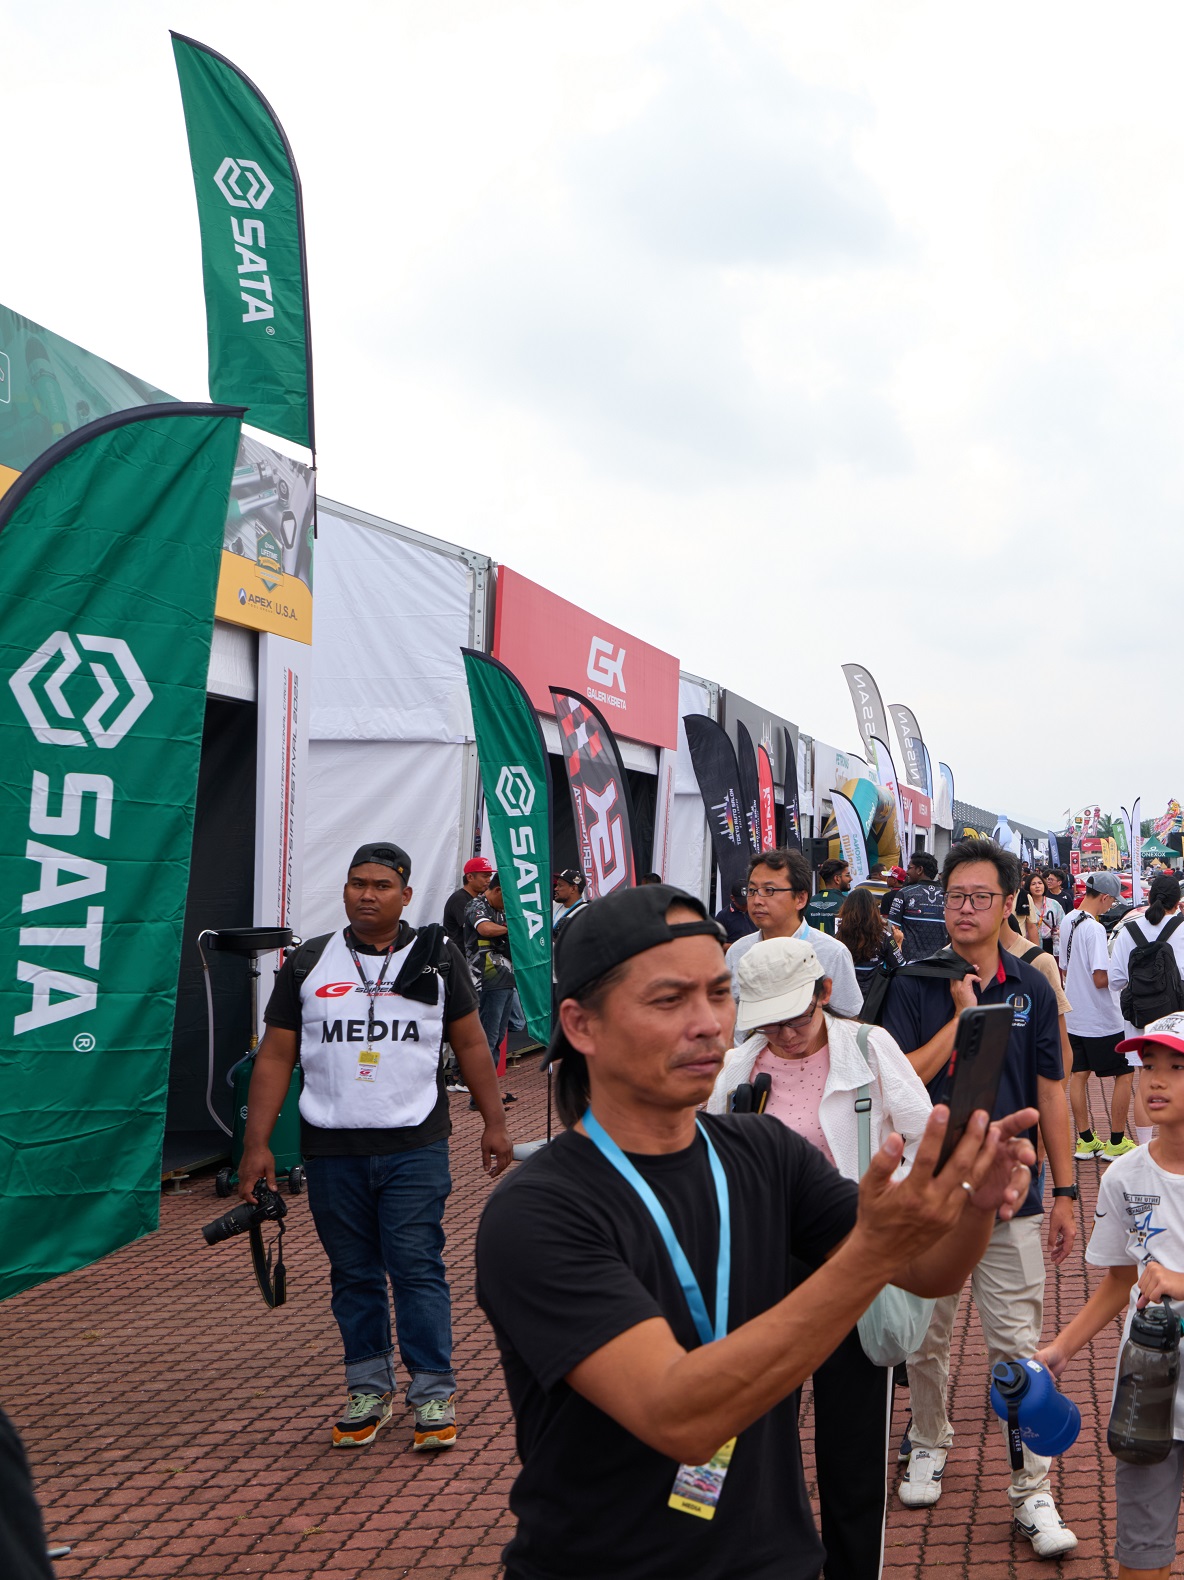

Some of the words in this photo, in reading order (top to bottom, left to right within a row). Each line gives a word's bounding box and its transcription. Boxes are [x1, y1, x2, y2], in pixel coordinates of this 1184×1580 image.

[231, 217, 274, 323] SATA
[248, 593, 273, 610] APEX
[275, 602, 298, 620] U.S.A.
[587, 635, 627, 693] GK
[587, 687, 607, 701] GALERI
[606, 694, 627, 711] KERETA
[13, 769, 114, 1036] SATA
[509, 827, 544, 940] SATA
[321, 1020, 420, 1043] MEDIA
[682, 1501, 702, 1512] MEDIA
